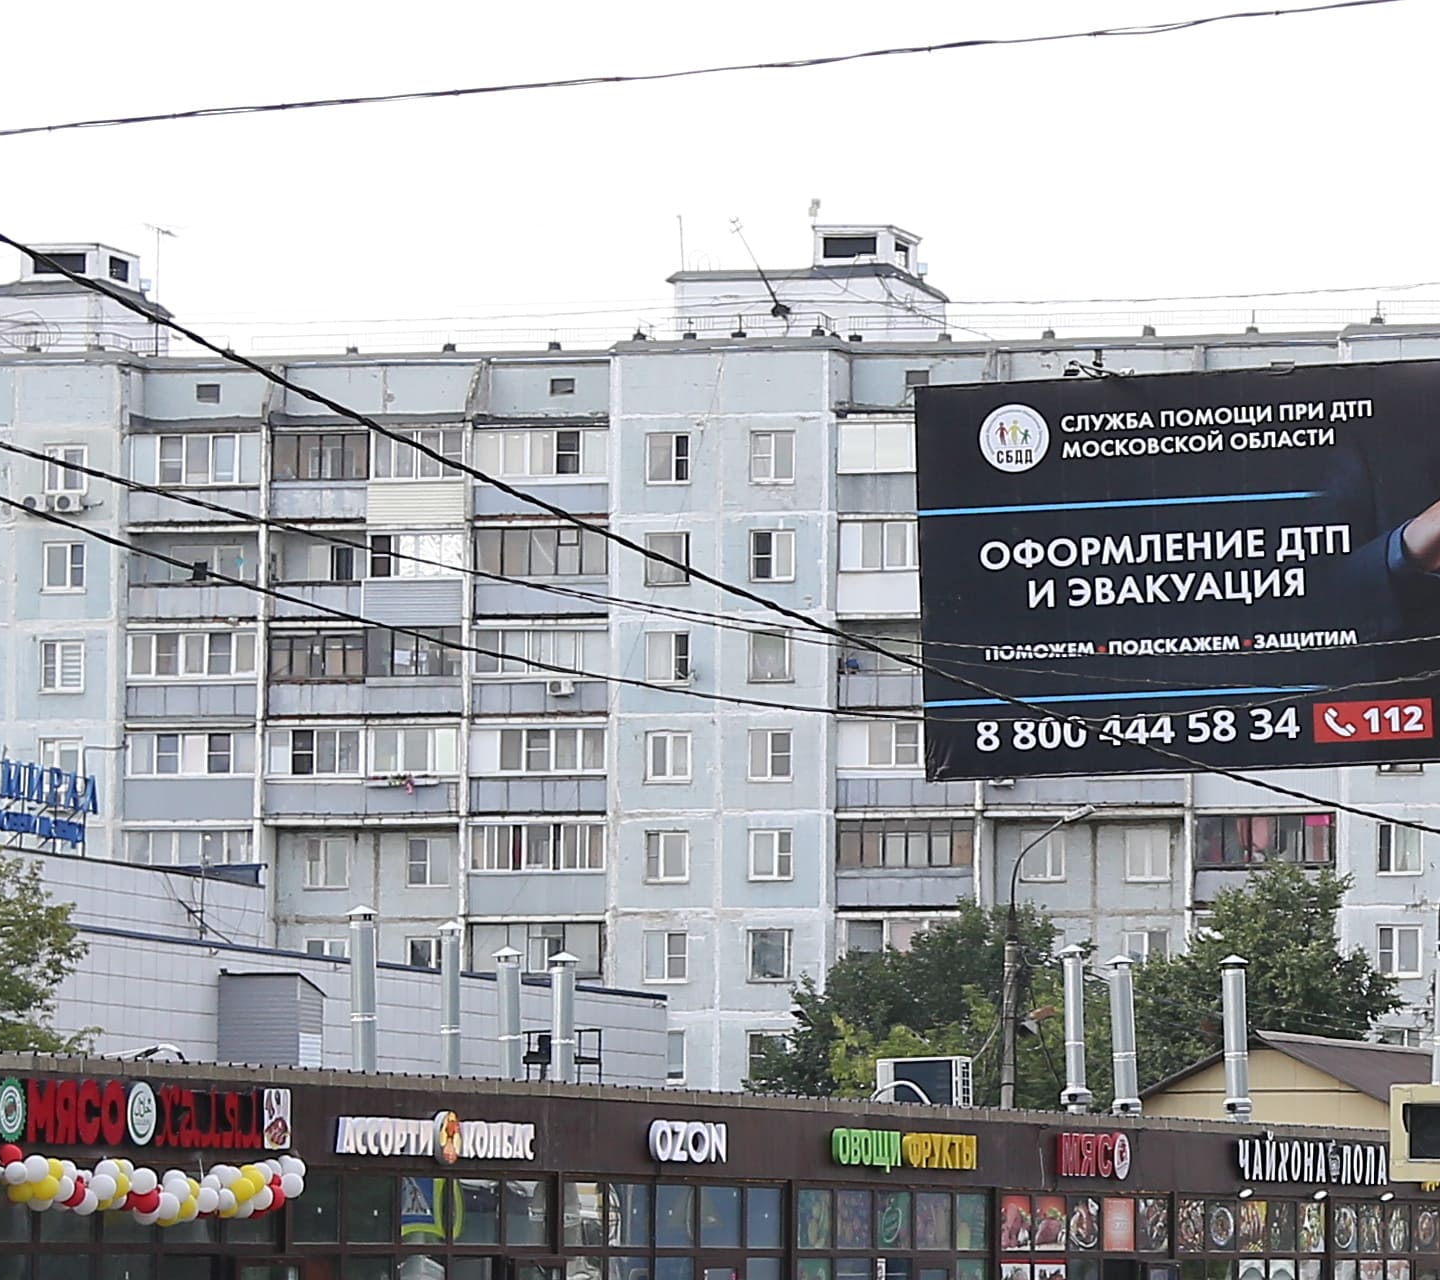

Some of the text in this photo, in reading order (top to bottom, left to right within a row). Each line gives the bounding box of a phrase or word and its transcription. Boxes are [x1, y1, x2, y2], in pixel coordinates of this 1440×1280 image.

[1061, 400, 1373, 433] СЛУЖБА ПОМОЩИ ПРИ ДТП
[996, 449, 1033, 464] СБДД
[1061, 428, 1335, 459] МОСКОВСКОЙ ОБЛАСТИ
[979, 525, 1351, 570] ОФОРМЛЕНИЕ ДТП
[1028, 567, 1305, 608] И ЭВАКУАЦИЯ
[985, 630, 1357, 661] ПОМОЖЕМ ПОДСКАЖЕМ ЗАЩИТИМ
[976, 706, 1299, 751] 8 800 444 58 34
[1363, 705, 1425, 734] 112
[26, 1078, 126, 1146] МЯСО
[335, 1117, 536, 1161] АССОРТИ КОЛБАС
[649, 1120, 727, 1164] OZON
[832, 1127, 977, 1173] ОВОЩИ ФРУКТЫ
[1238, 1128, 1326, 1183] ЧАЙХОНА
